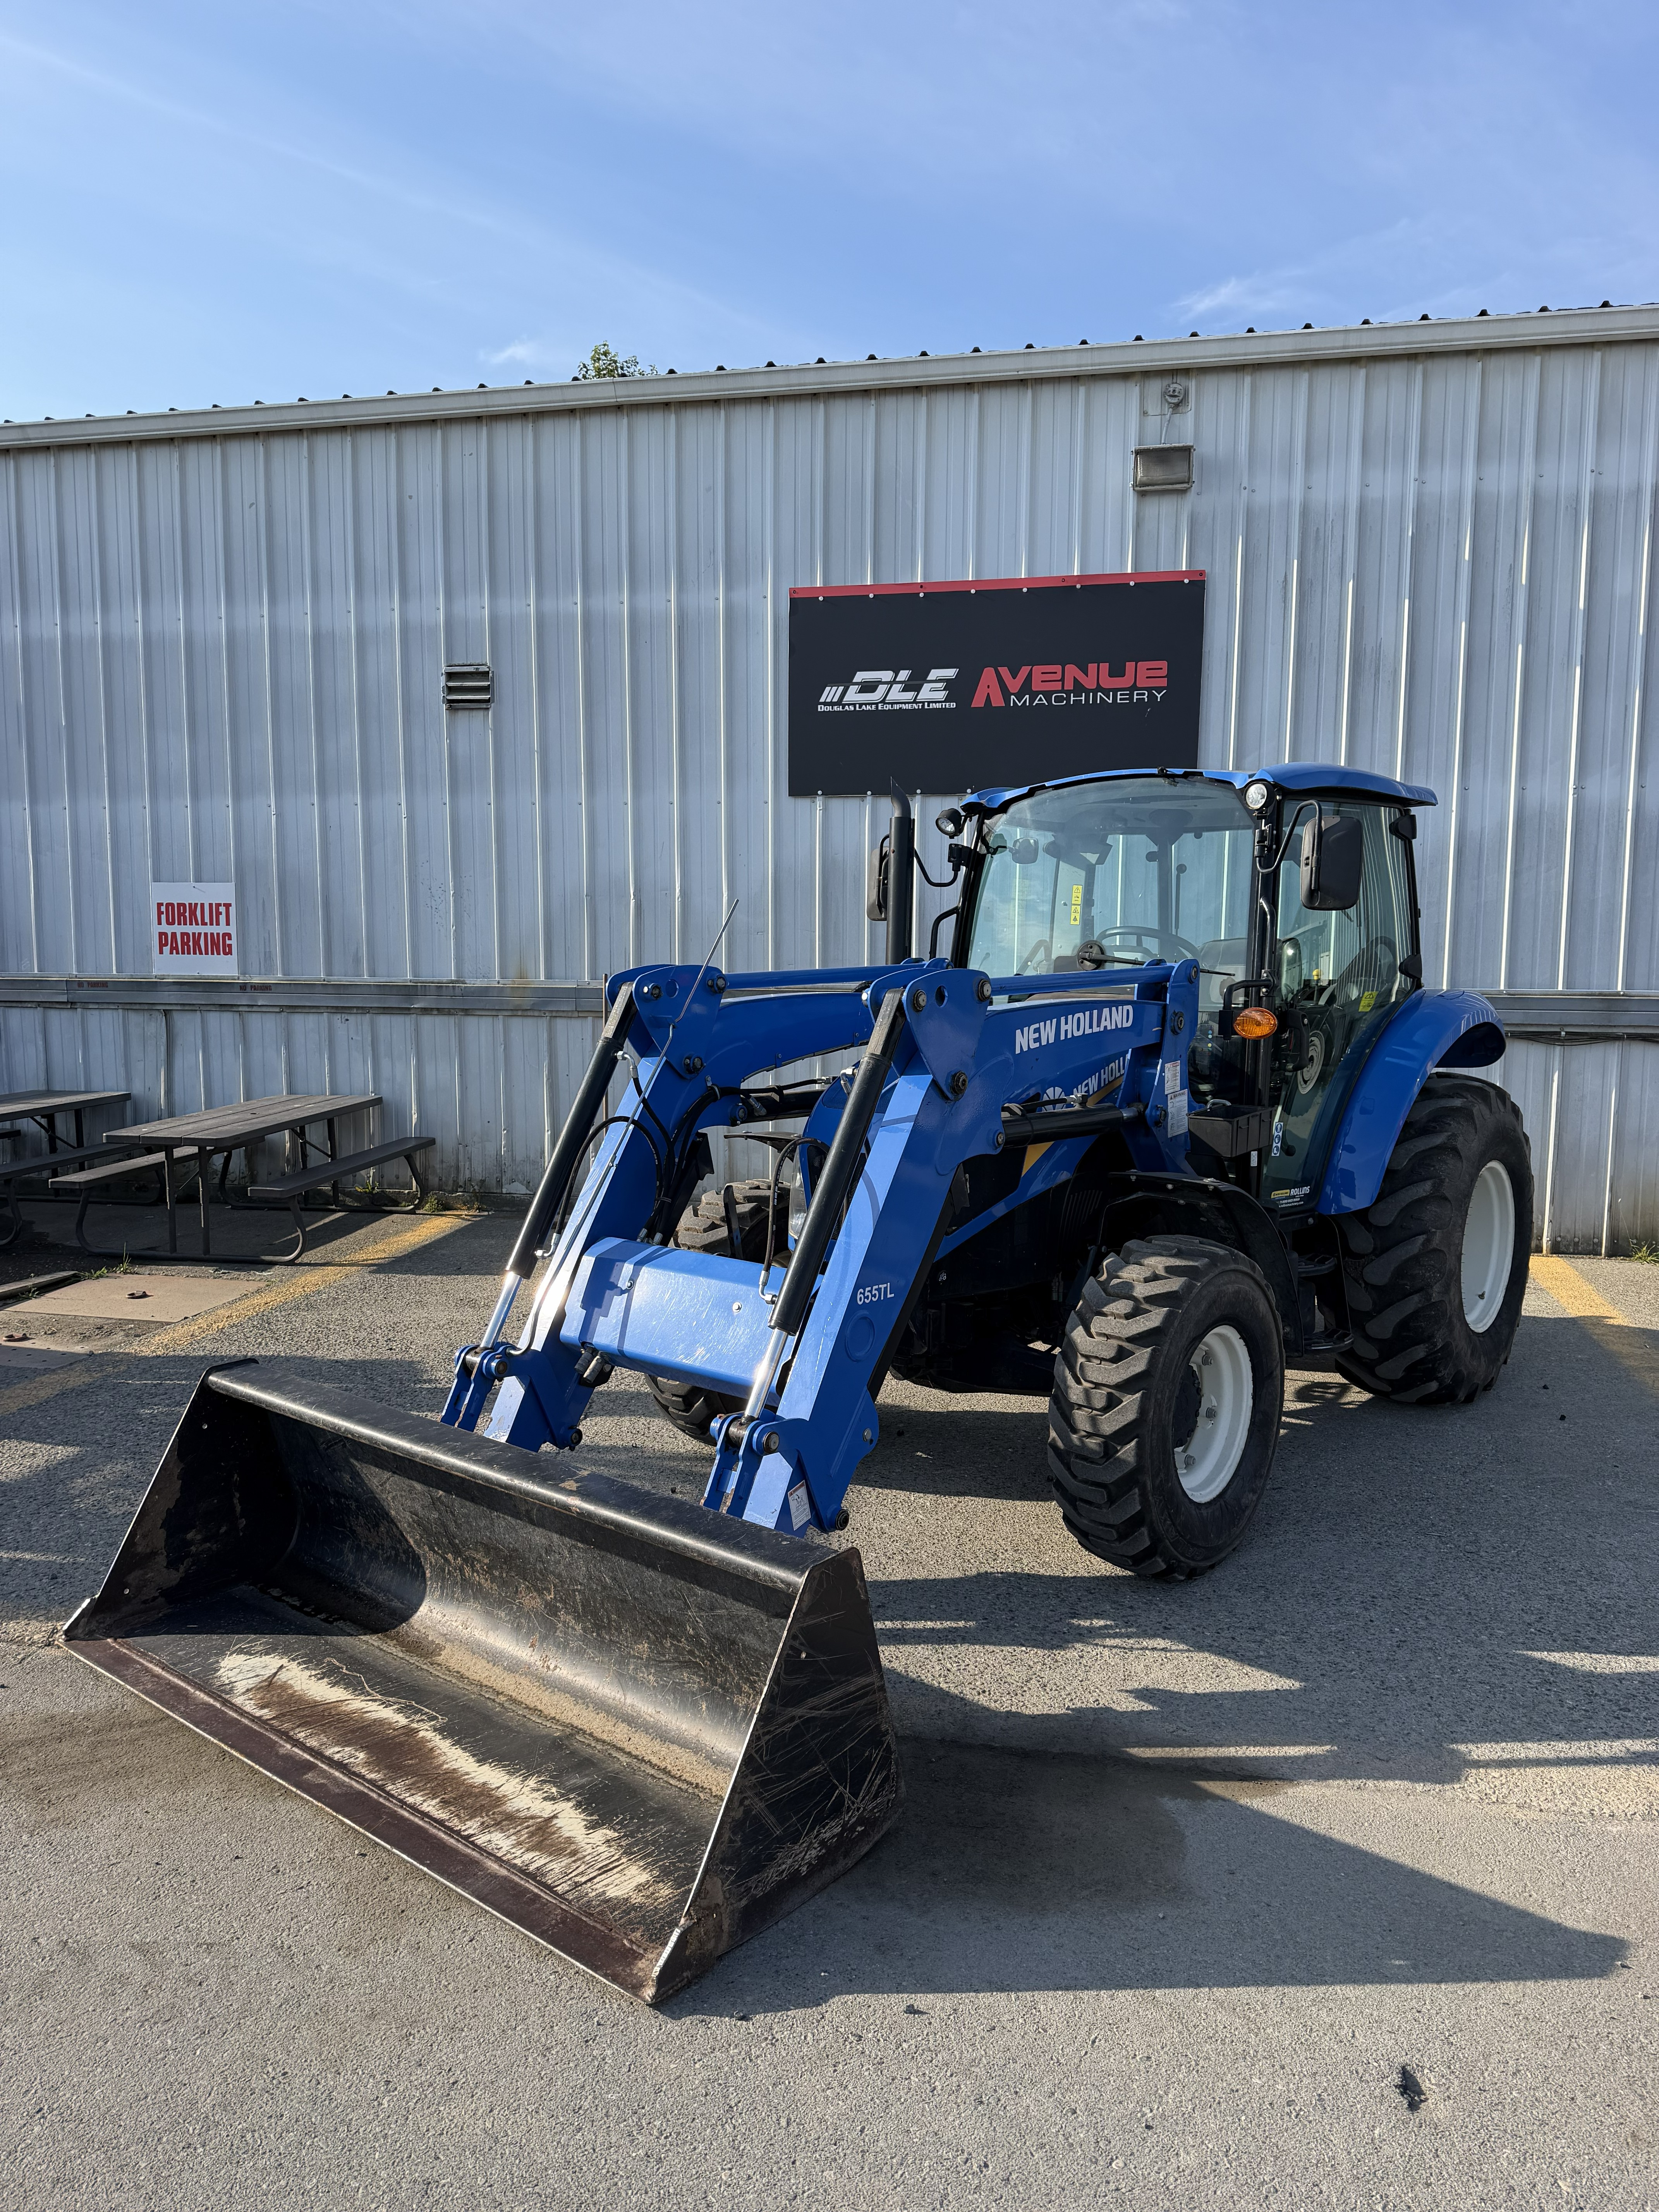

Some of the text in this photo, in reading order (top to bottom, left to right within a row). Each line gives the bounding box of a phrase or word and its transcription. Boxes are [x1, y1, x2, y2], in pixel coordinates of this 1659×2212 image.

[842, 668, 959, 703] DLE
[971, 661, 1168, 708] AVENUE
[1010, 690, 1167, 706] MACHINERY
[156, 902, 232, 926] FORKLIFT
[158, 932, 233, 956] PARKING
[1015, 1005, 1133, 1054] NEW HOLLAND
[1101, 1053, 1129, 1087] HOLL
[1290, 1186, 1310, 1196] ROLLINS
[857, 1283, 894, 1305] 655TL
